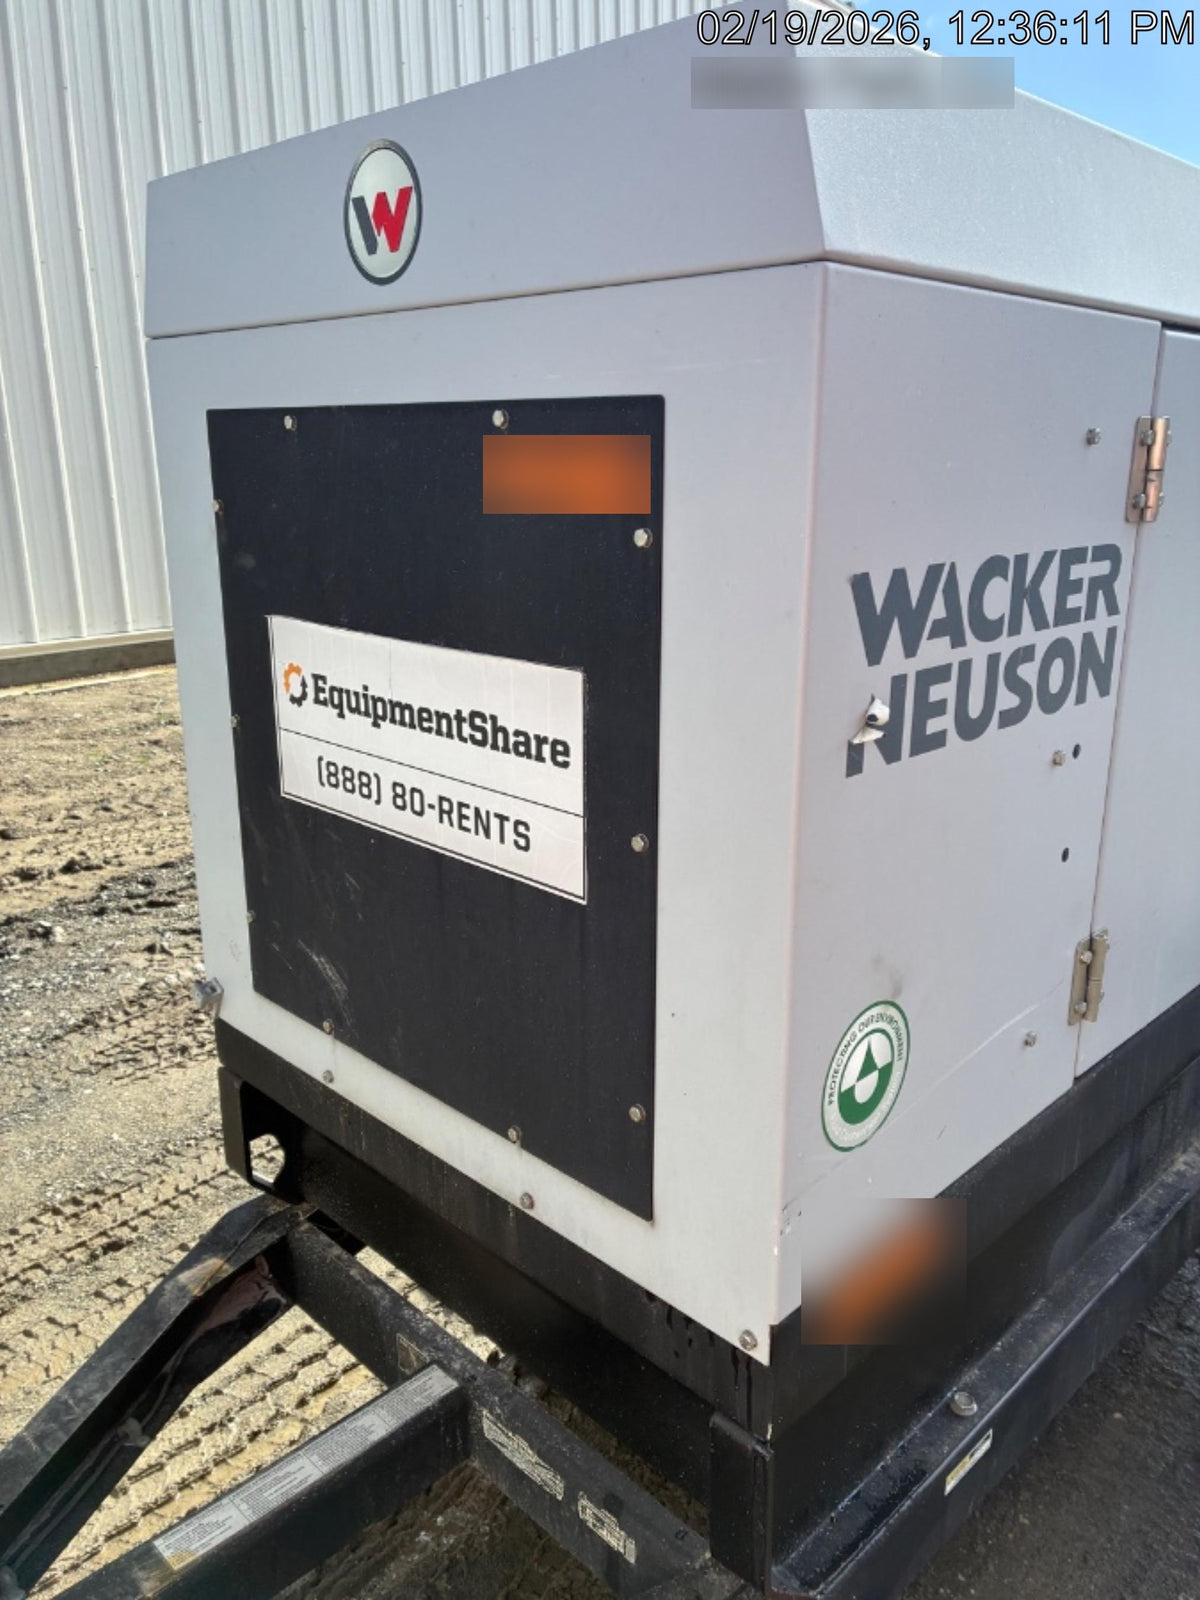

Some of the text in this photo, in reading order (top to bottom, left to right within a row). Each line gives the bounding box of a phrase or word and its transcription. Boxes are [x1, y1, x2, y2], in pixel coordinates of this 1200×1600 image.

[351, 187, 413, 256] W
[850, 543, 1123, 667] WACKER
[311, 672, 571, 769] EquipmentShare
[846, 626, 1118, 778] NEUSON
[317, 755, 532, 853] (888) 80-RENTS
[828, 1032, 858, 1106] PROTECTING
